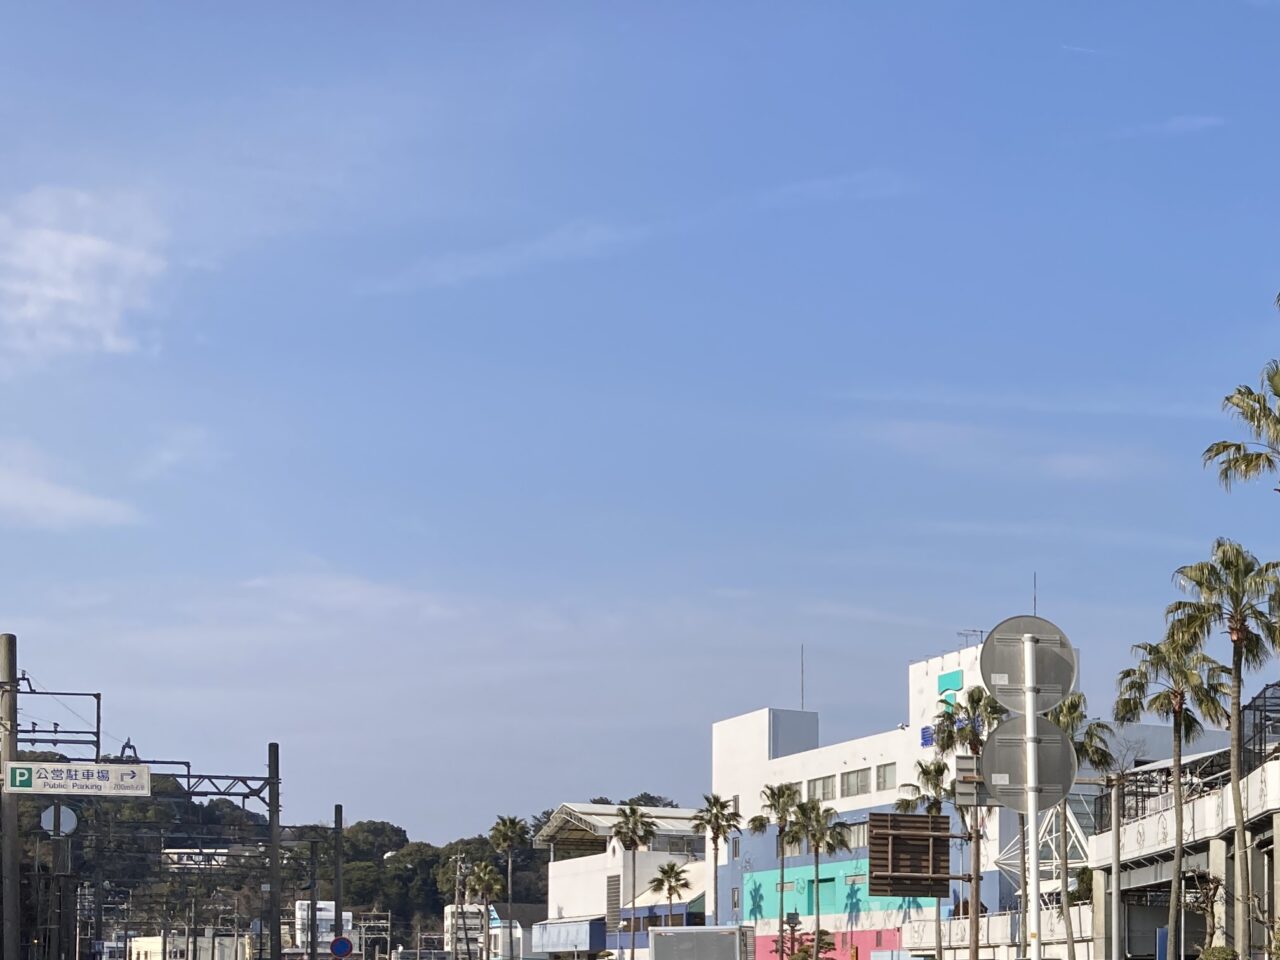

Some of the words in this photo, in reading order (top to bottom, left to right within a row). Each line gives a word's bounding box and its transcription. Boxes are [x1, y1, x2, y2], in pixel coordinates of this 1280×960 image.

[16, 769, 28, 786] P
[36, 767, 110, 782] 公営駐車場
[43, 781, 67, 789] Public
[72, 782, 102, 791] Parking
